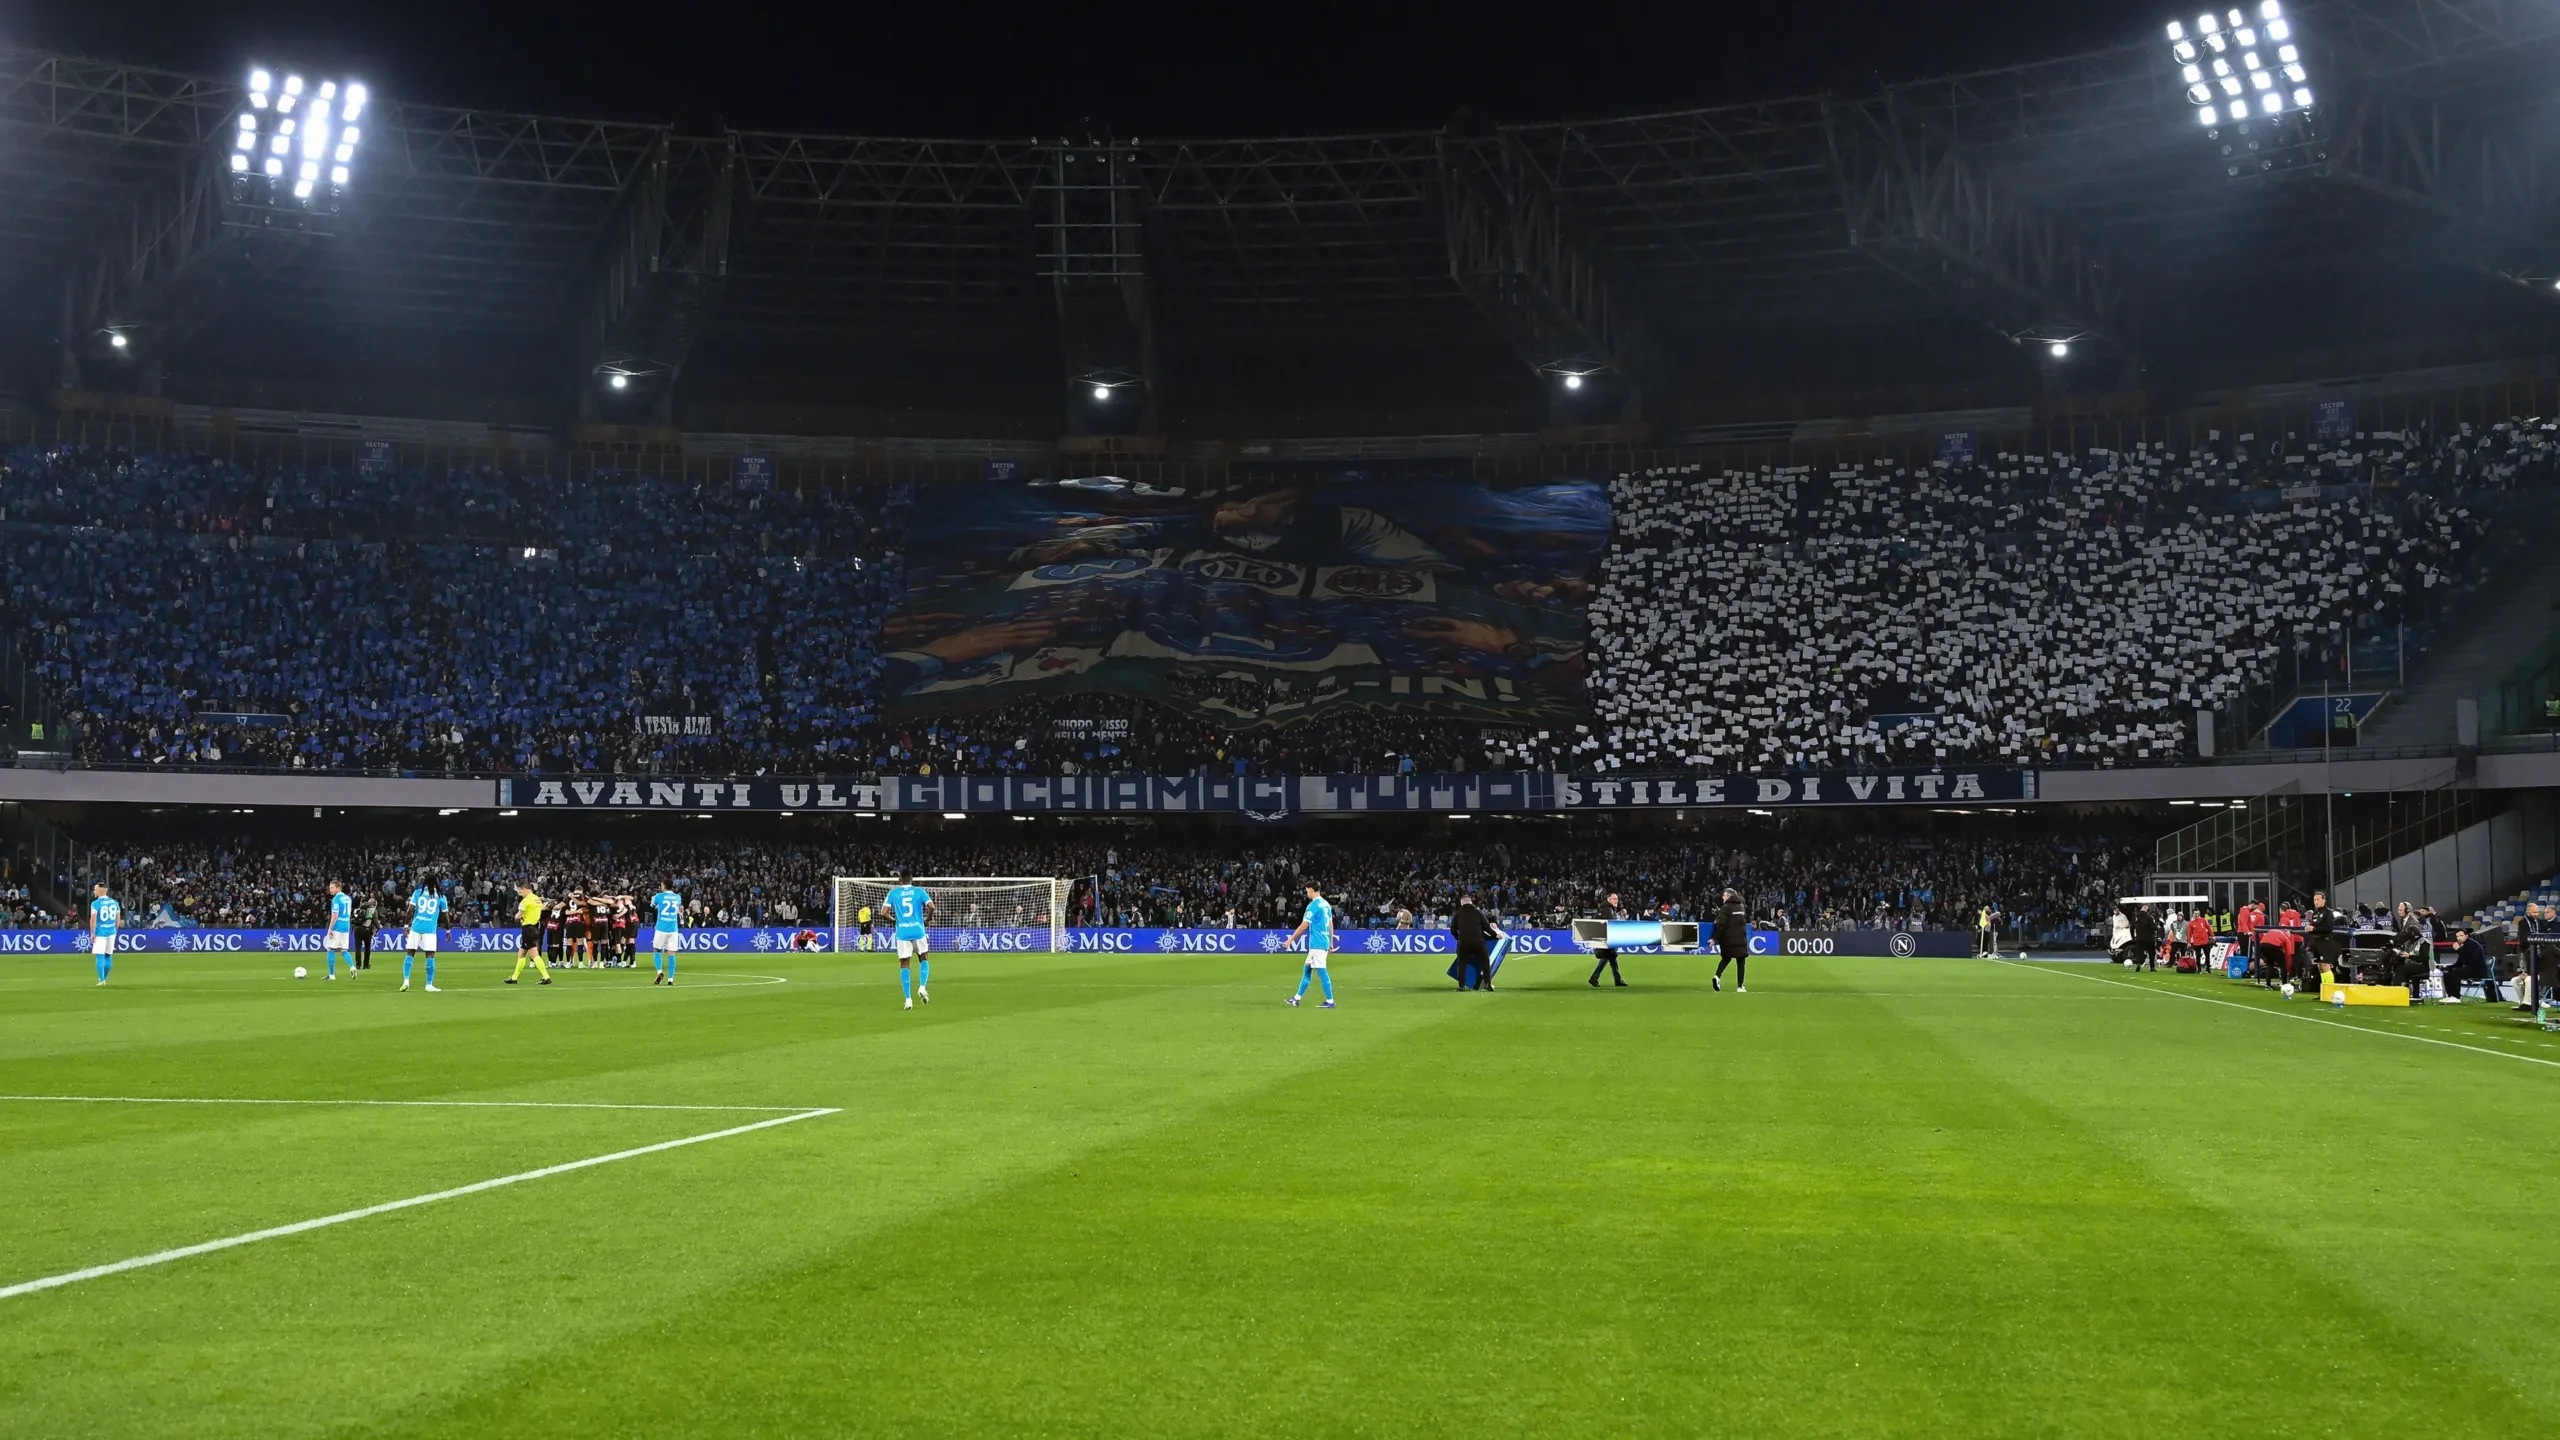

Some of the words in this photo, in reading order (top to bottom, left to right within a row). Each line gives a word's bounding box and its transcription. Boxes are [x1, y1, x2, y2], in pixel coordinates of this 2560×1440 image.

[1944, 432, 1968, 440] SECTOR
[2335, 698, 2352, 712] 22
[634, 716, 643, 734] A
[644, 715, 680, 736] TESTA
[683, 716, 712, 736] ALTA
[1053, 719, 1094, 731] CHIODO
[534, 781, 751, 807] AVANTI
[779, 783, 882, 808] ULT
[1564, 778, 1725, 806] STILE
[1757, 776, 1821, 802] DI
[1846, 773, 1984, 799] VITA
[100, 903, 118, 922] 68
[417, 895, 439, 915] 99
[569, 899, 578, 911] 9
[661, 899, 679, 916] 23
[902, 897, 914, 918] 5
[1, 934, 51, 951] MSC
[192, 934, 242, 951] MSC
[679, 932, 729, 950] MSC
[776, 932, 829, 950] MC
[979, 932, 1031, 950] MSC
[1079, 932, 1132, 951] MSC
[1182, 934, 1236, 952] MSC
[1390, 934, 1446, 952] MSC
[1511, 934, 1551, 953] SC
[1787, 937, 1834, 954] 00:00
